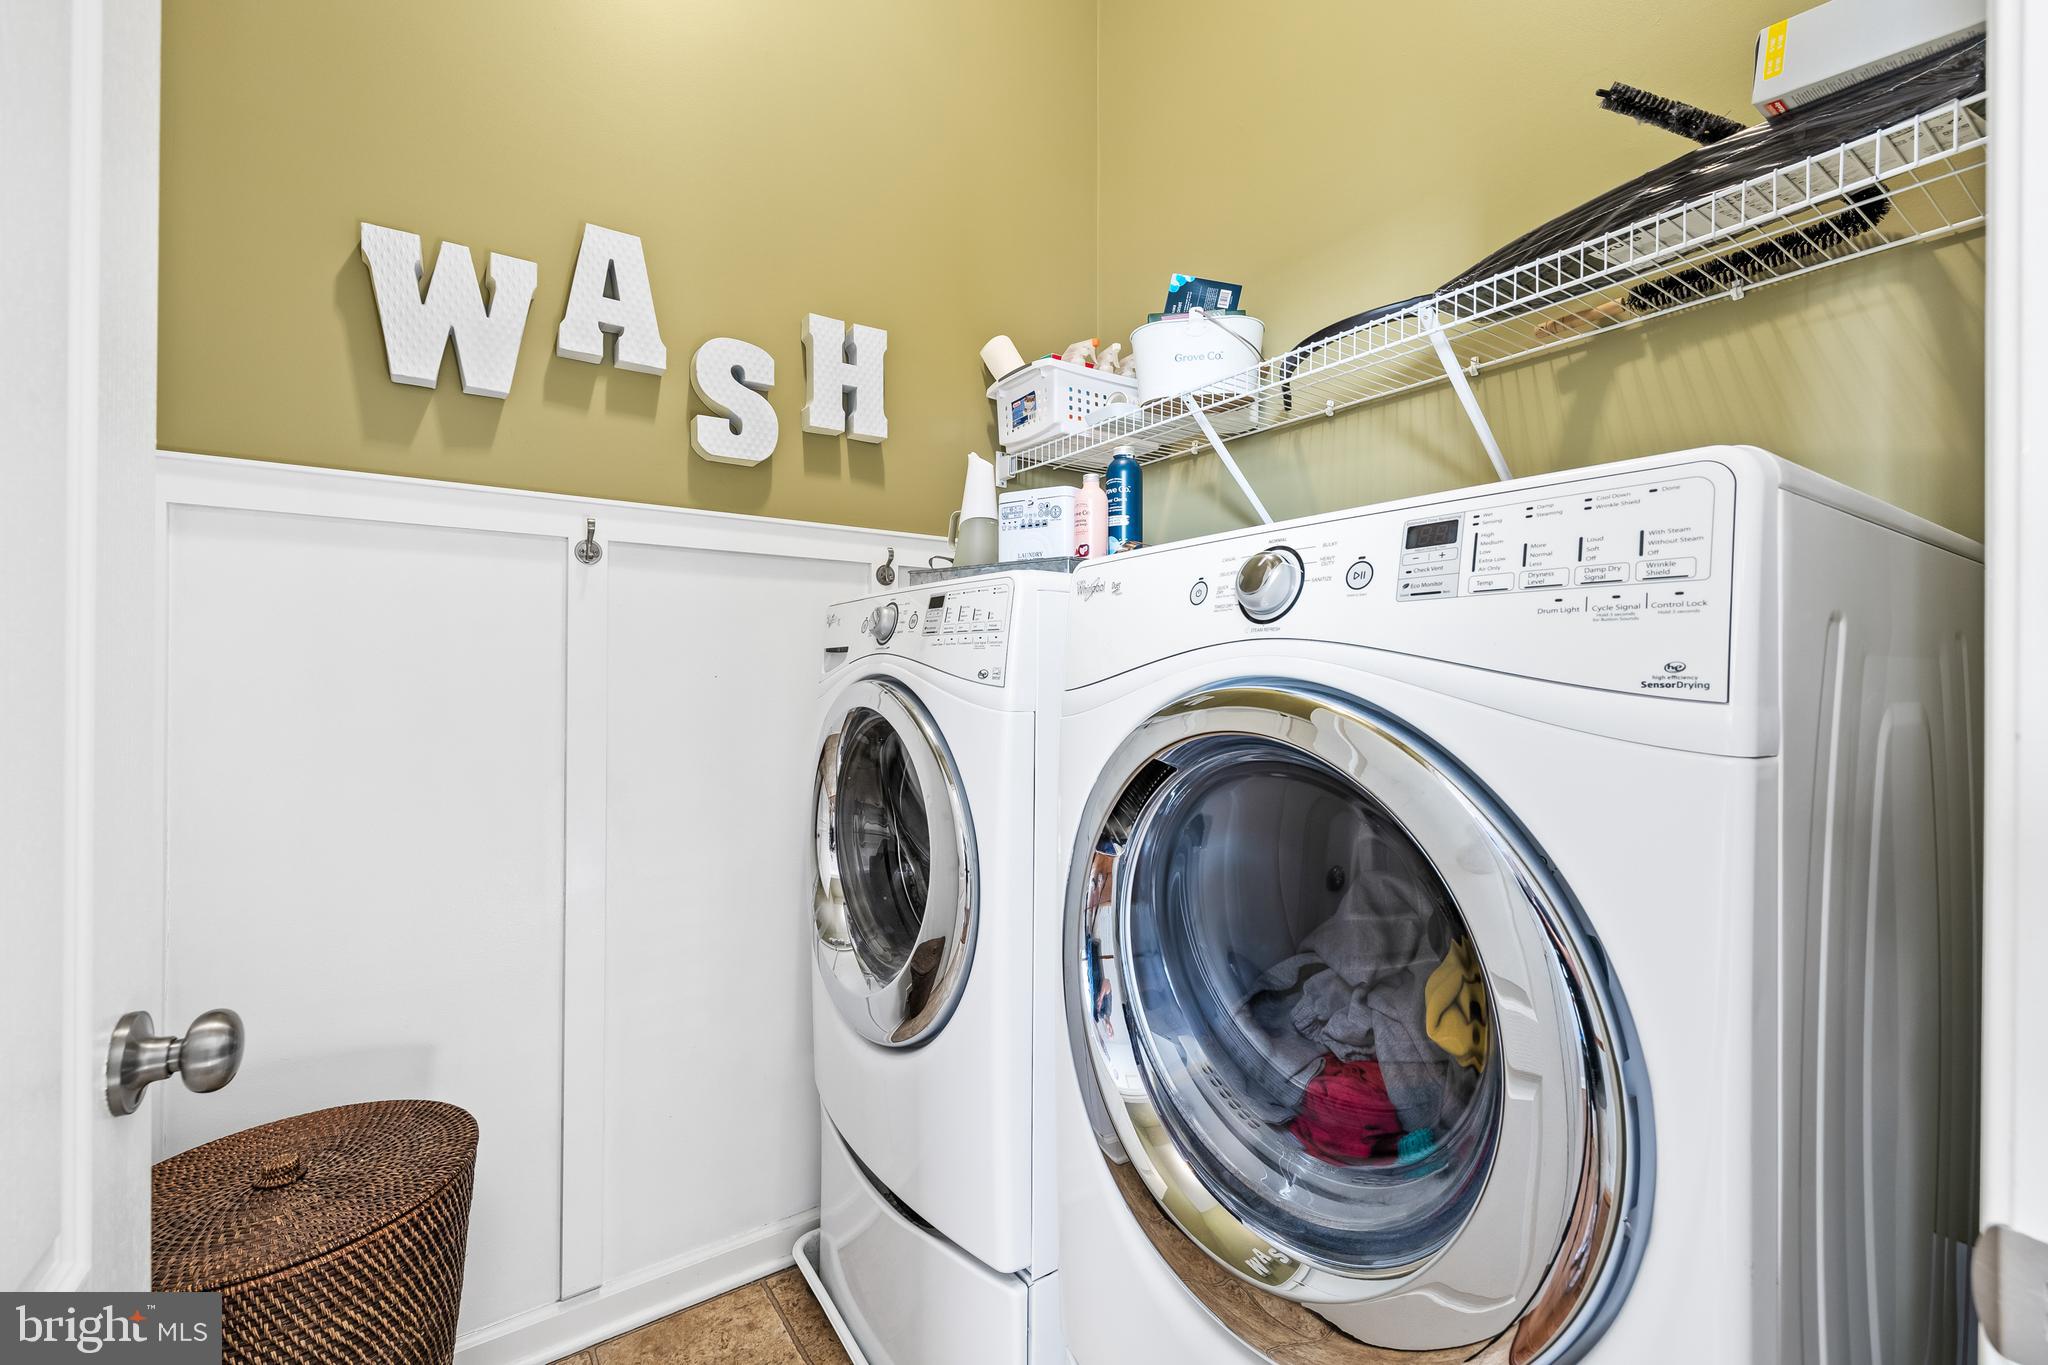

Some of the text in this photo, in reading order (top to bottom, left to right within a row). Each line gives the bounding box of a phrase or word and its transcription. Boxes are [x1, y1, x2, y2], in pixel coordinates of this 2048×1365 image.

[361, 221, 888, 468] WASH
[1174, 352, 1205, 362] Grove
[1612, 491, 1631, 499] Down
[1596, 502, 1619, 510] Wrinkle
[1668, 526, 1691, 534] Steam
[1680, 535, 1704, 543] Steam
[1530, 551, 1553, 559] Normal
[1646, 560, 1677, 569] Wrinkle
[1584, 565, 1622, 575] Damp Dry
[1646, 569, 1671, 577] Shield
[1528, 571, 1554, 580] Dryness
[1584, 574, 1606, 582] Signal
[1476, 580, 1494, 588] Temp
[1591, 603, 1641, 613] Cycle Signal
[1651, 599, 1708, 609] Control Lock
[1560, 606, 1580, 615] Light
[1640, 680, 1710, 691] SensorDrying
